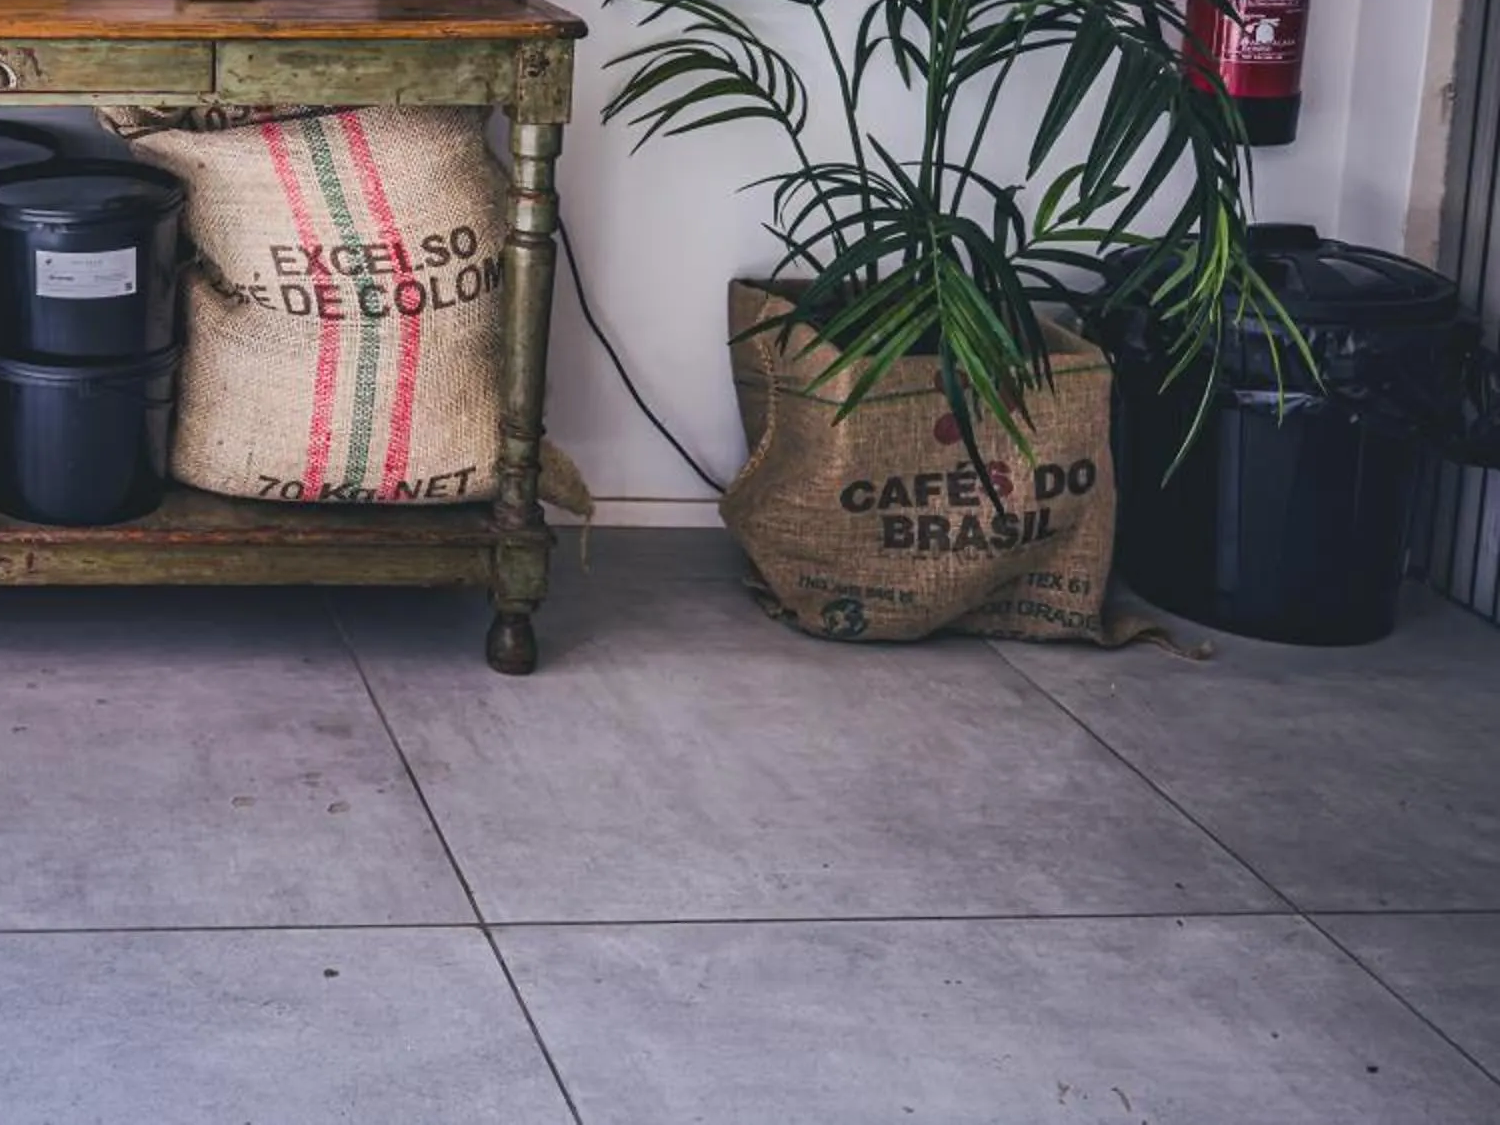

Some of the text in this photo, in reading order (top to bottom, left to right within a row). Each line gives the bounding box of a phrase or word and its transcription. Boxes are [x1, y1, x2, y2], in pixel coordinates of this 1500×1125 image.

[269, 225, 478, 277] EXCELSO
[279, 283, 345, 320] DE
[257, 475, 305, 501] 70
[394, 466, 477, 501] NET
[1034, 457, 1097, 501] DO
[881, 506, 1058, 554] BRASIL
